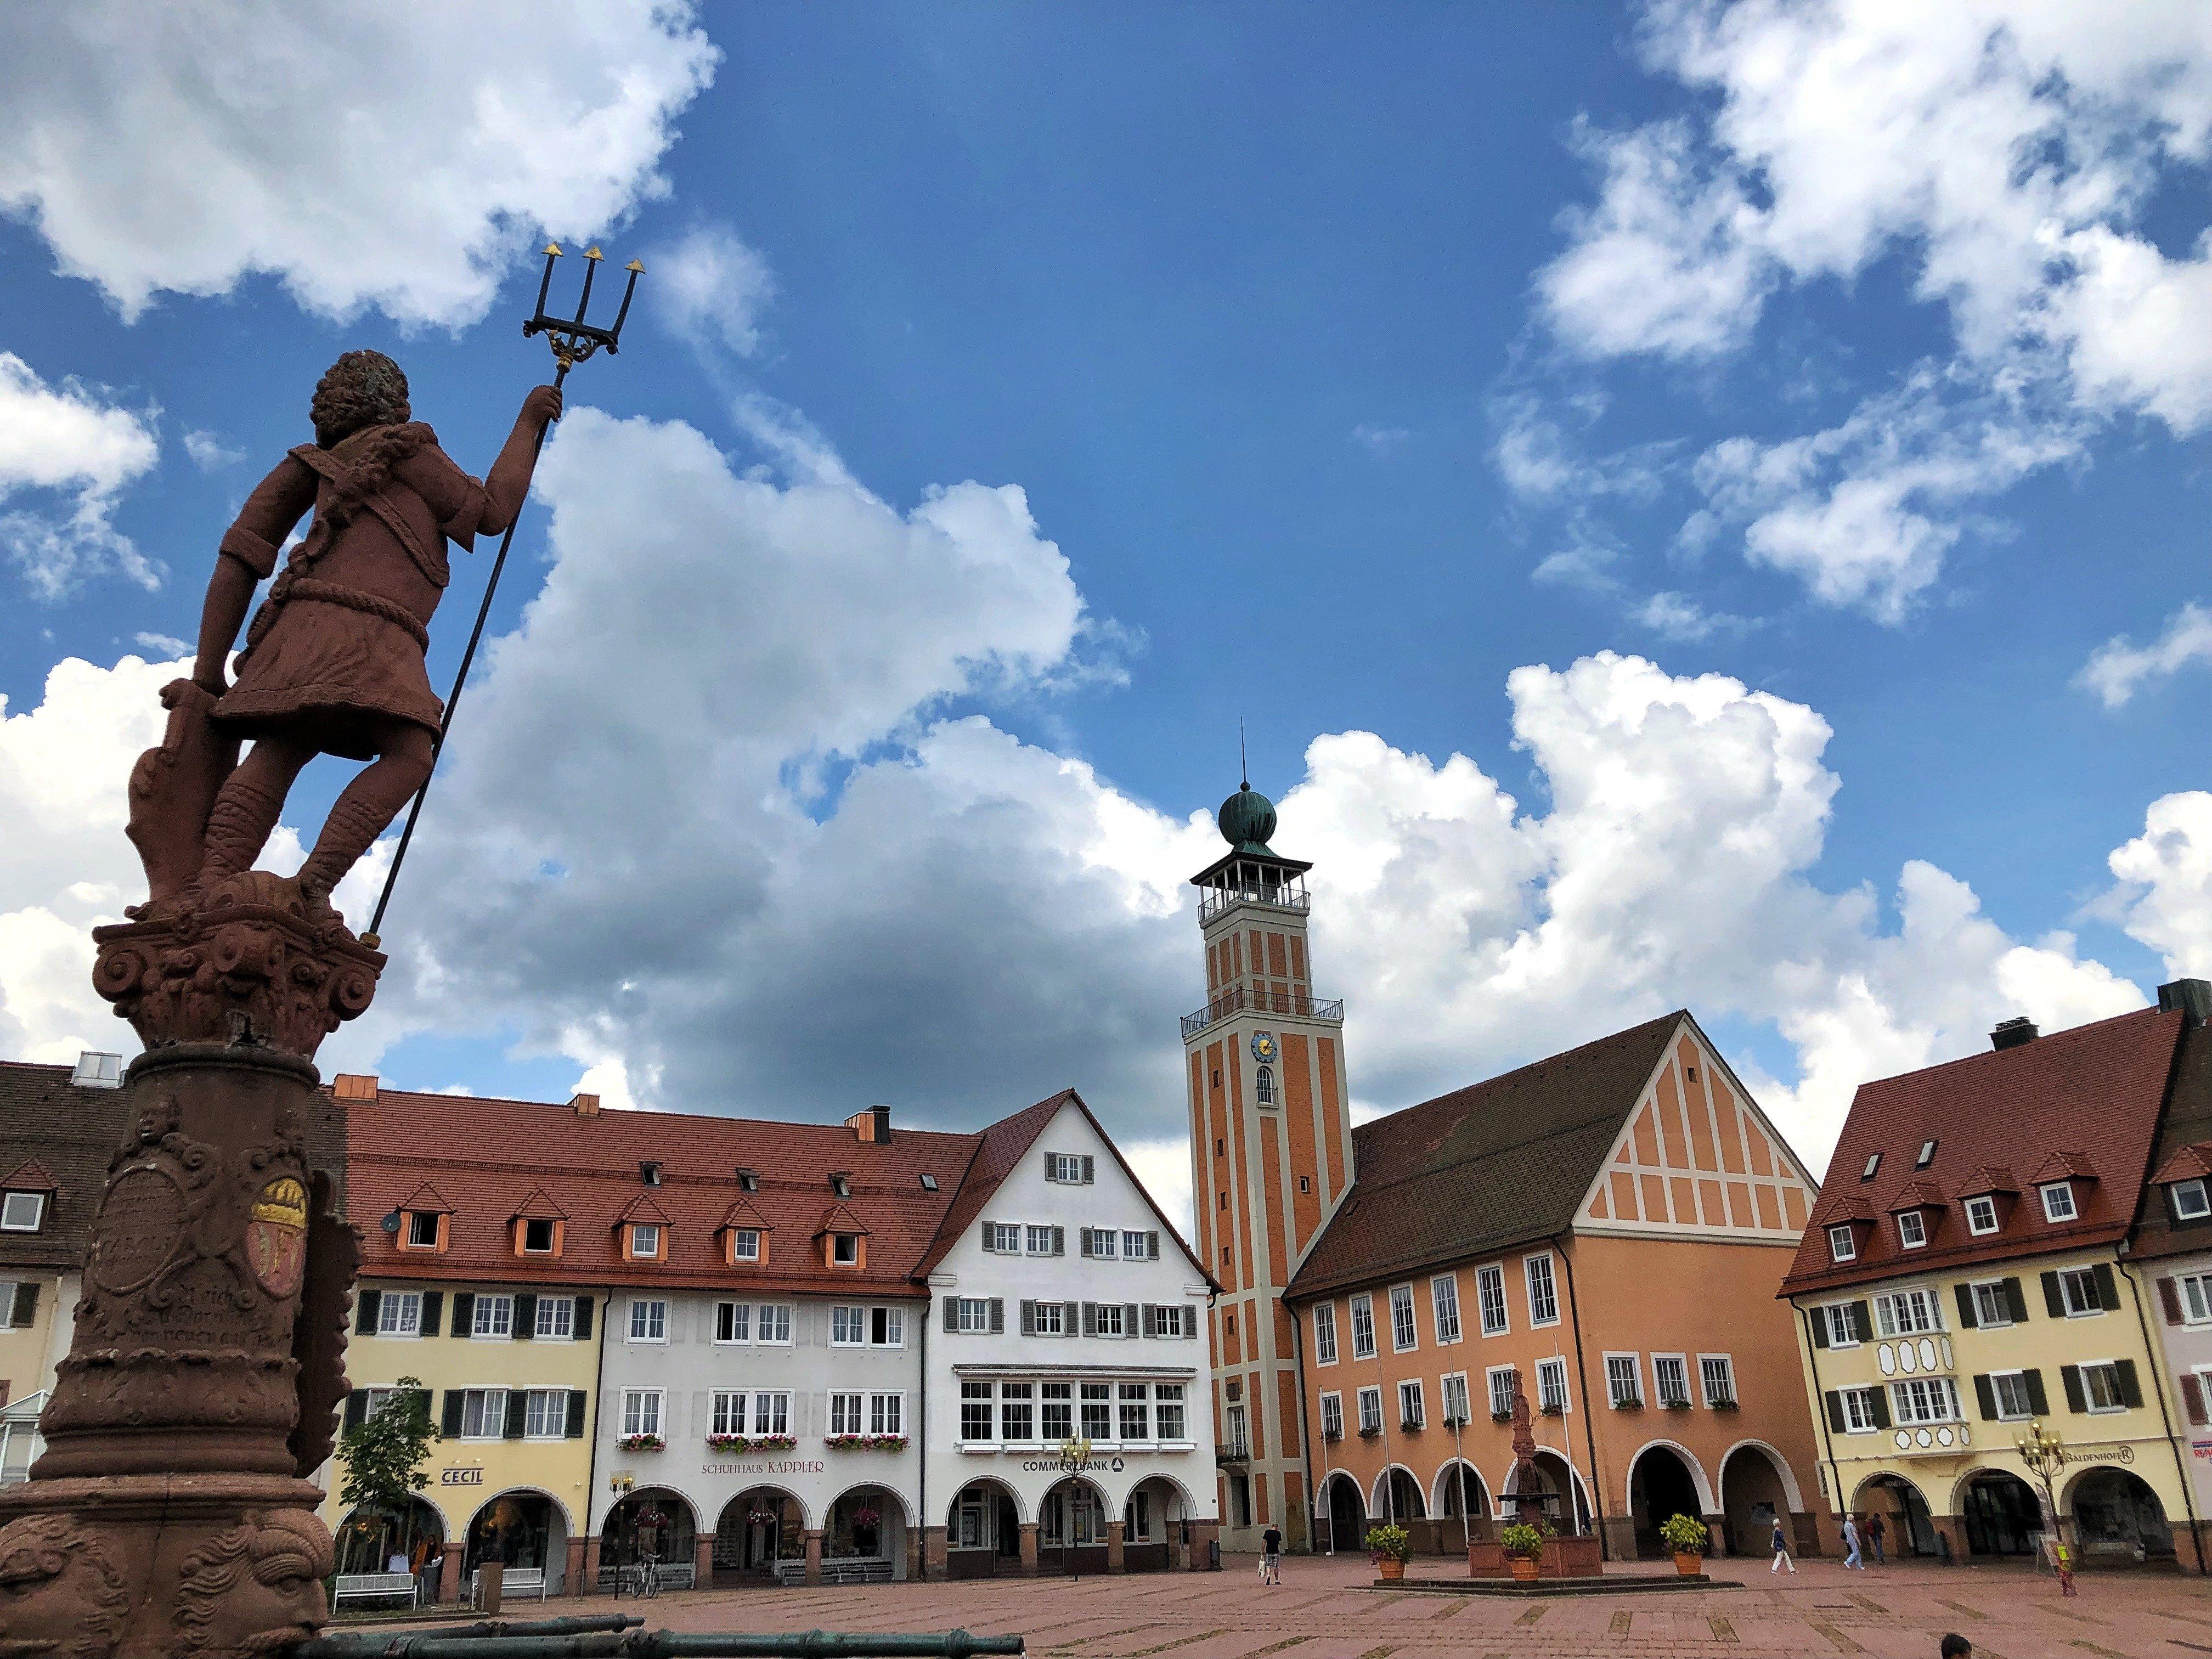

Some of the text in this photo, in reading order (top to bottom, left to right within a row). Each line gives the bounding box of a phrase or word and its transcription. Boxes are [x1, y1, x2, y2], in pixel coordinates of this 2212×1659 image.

[2063, 1449, 2132, 1464] BALDENHOFER
[702, 1461, 825, 1474] SCHUHHAUS KAPPLER
[441, 1470, 483, 1483] CECIL
